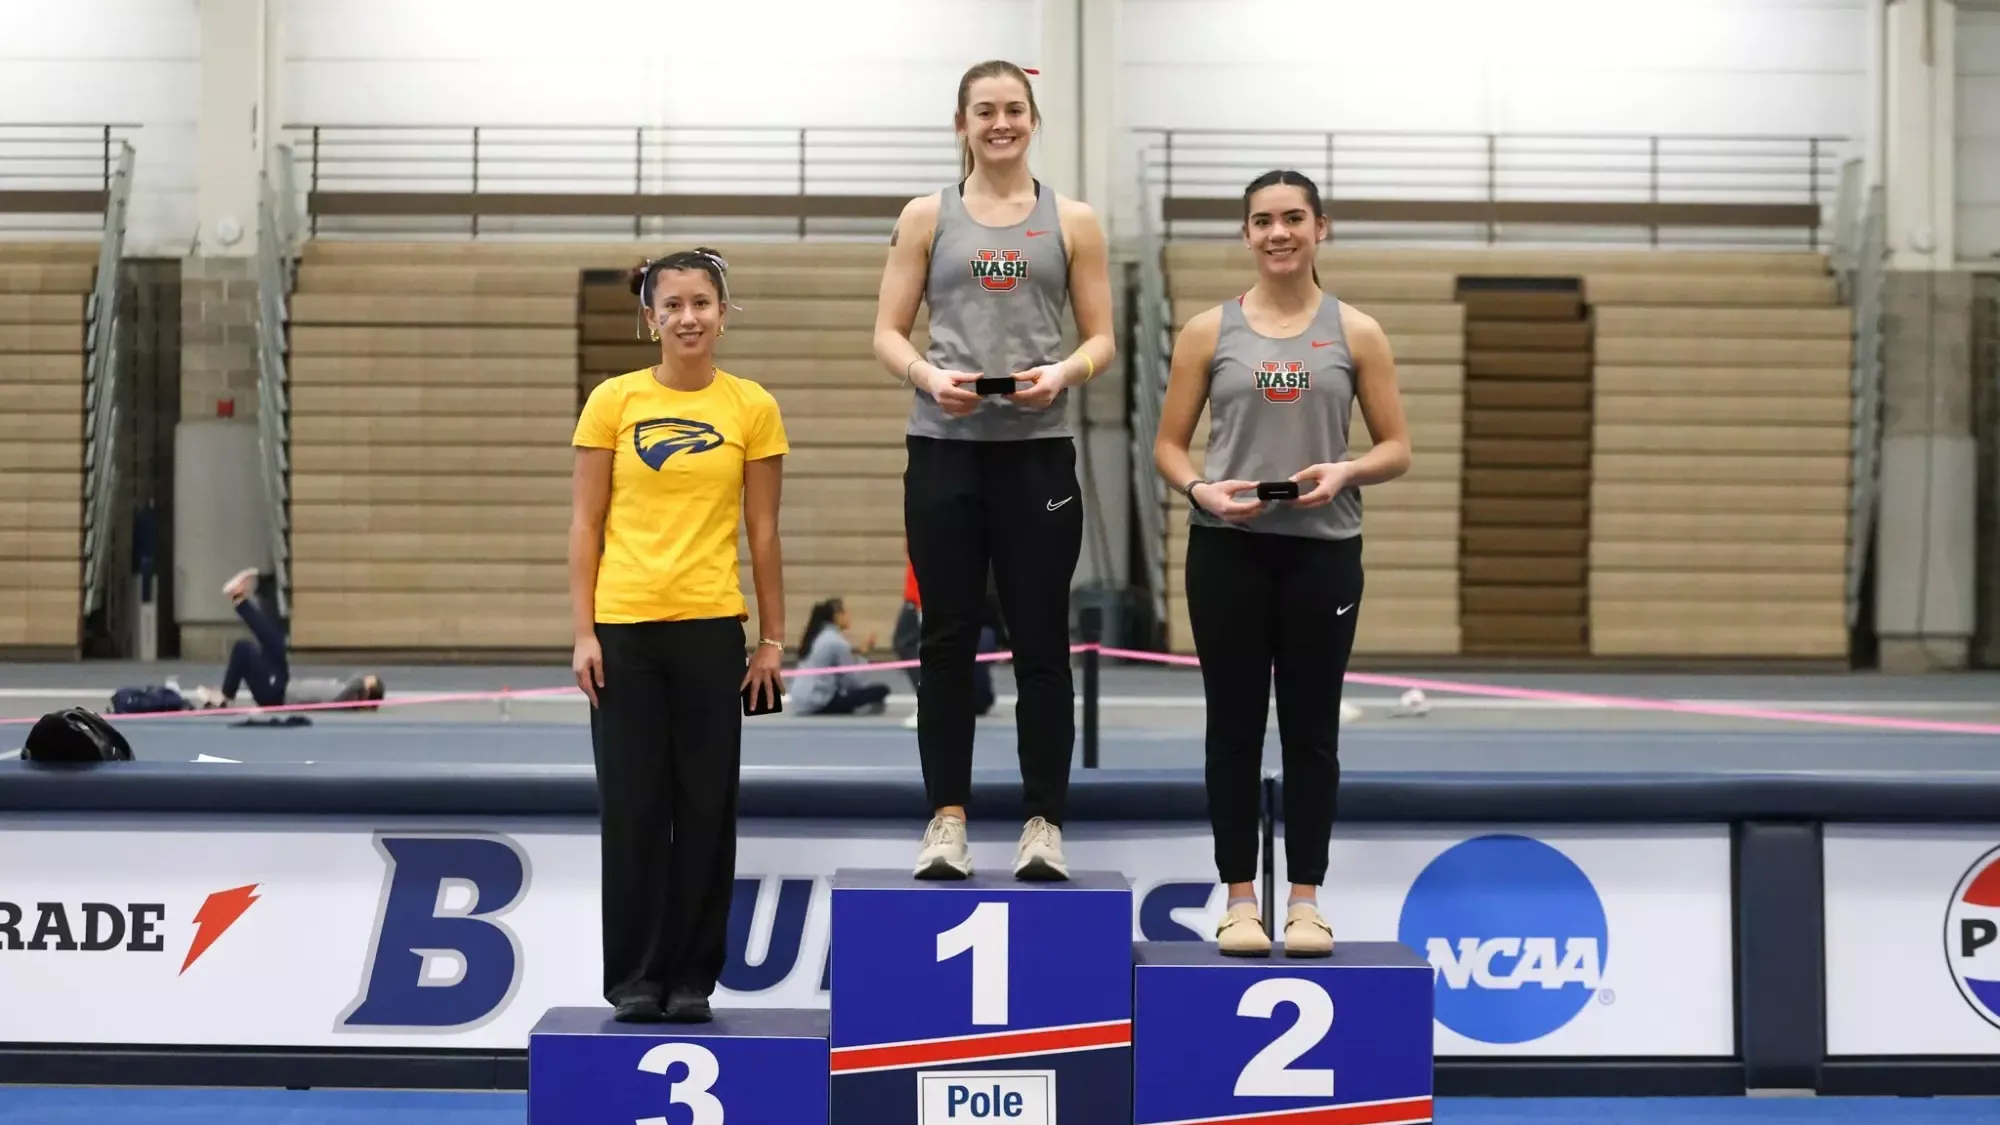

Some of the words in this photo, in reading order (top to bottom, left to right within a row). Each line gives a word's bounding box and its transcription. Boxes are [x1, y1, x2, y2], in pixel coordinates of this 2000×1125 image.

[969, 260, 1029, 279] WASH
[1254, 371, 1311, 390] WASH
[0, 901, 165, 952] RADE
[334, 829, 532, 1034] B
[1961, 918, 1998, 957] P
[936, 902, 1010, 1026] 1
[1426, 937, 1601, 990] NCAA
[1233, 977, 1335, 1097] 2
[635, 1042, 725, 1125] 3
[947, 1084, 1024, 1118] Pole
